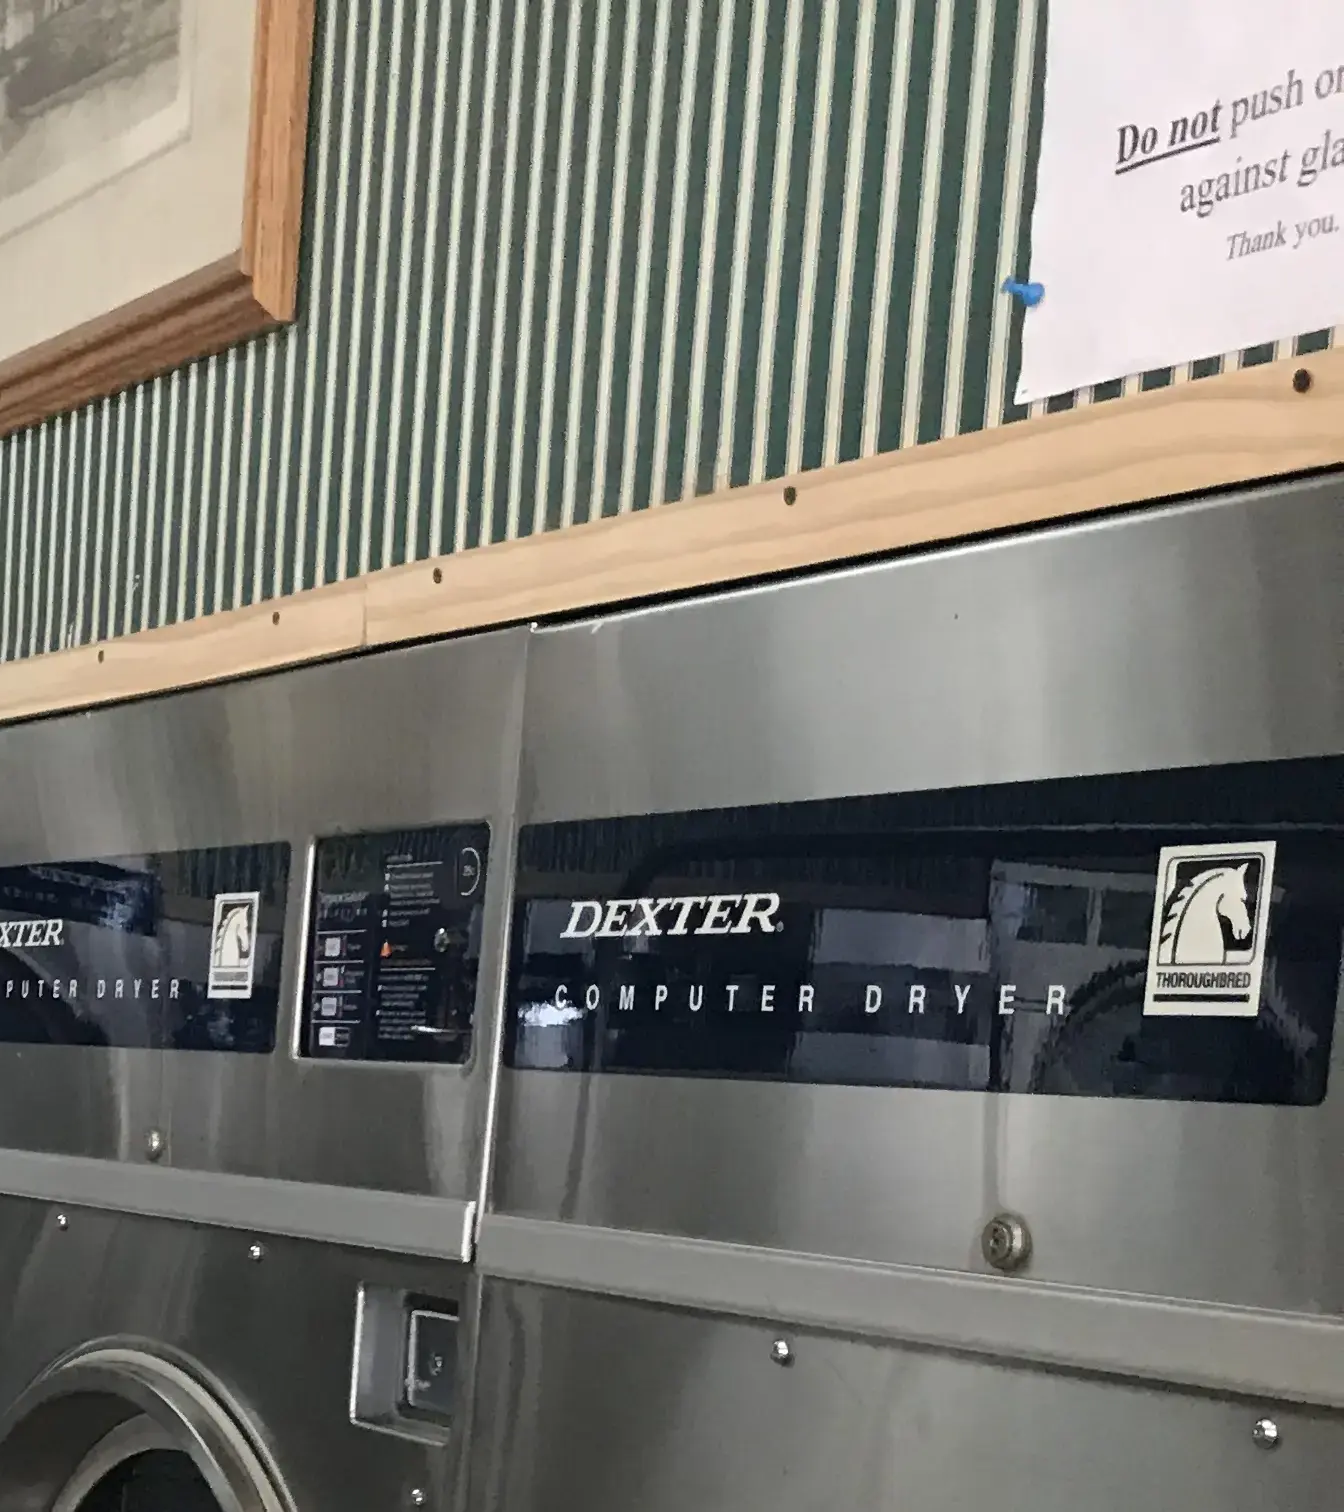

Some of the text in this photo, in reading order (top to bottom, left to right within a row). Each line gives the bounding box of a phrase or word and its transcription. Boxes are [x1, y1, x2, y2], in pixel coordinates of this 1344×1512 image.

[1116, 124, 1157, 165] Do
[1167, 98, 1221, 148] not
[1230, 69, 1303, 139] push
[1180, 148, 1290, 218] against
[1225, 215, 1340, 261] Thank you.
[560, 892, 780, 939] DEXTER
[97, 978, 180, 999] DRYER
[555, 984, 1067, 1016] COMPUTER DRYER
[1156, 971, 1252, 990] THOROUGHBRED
